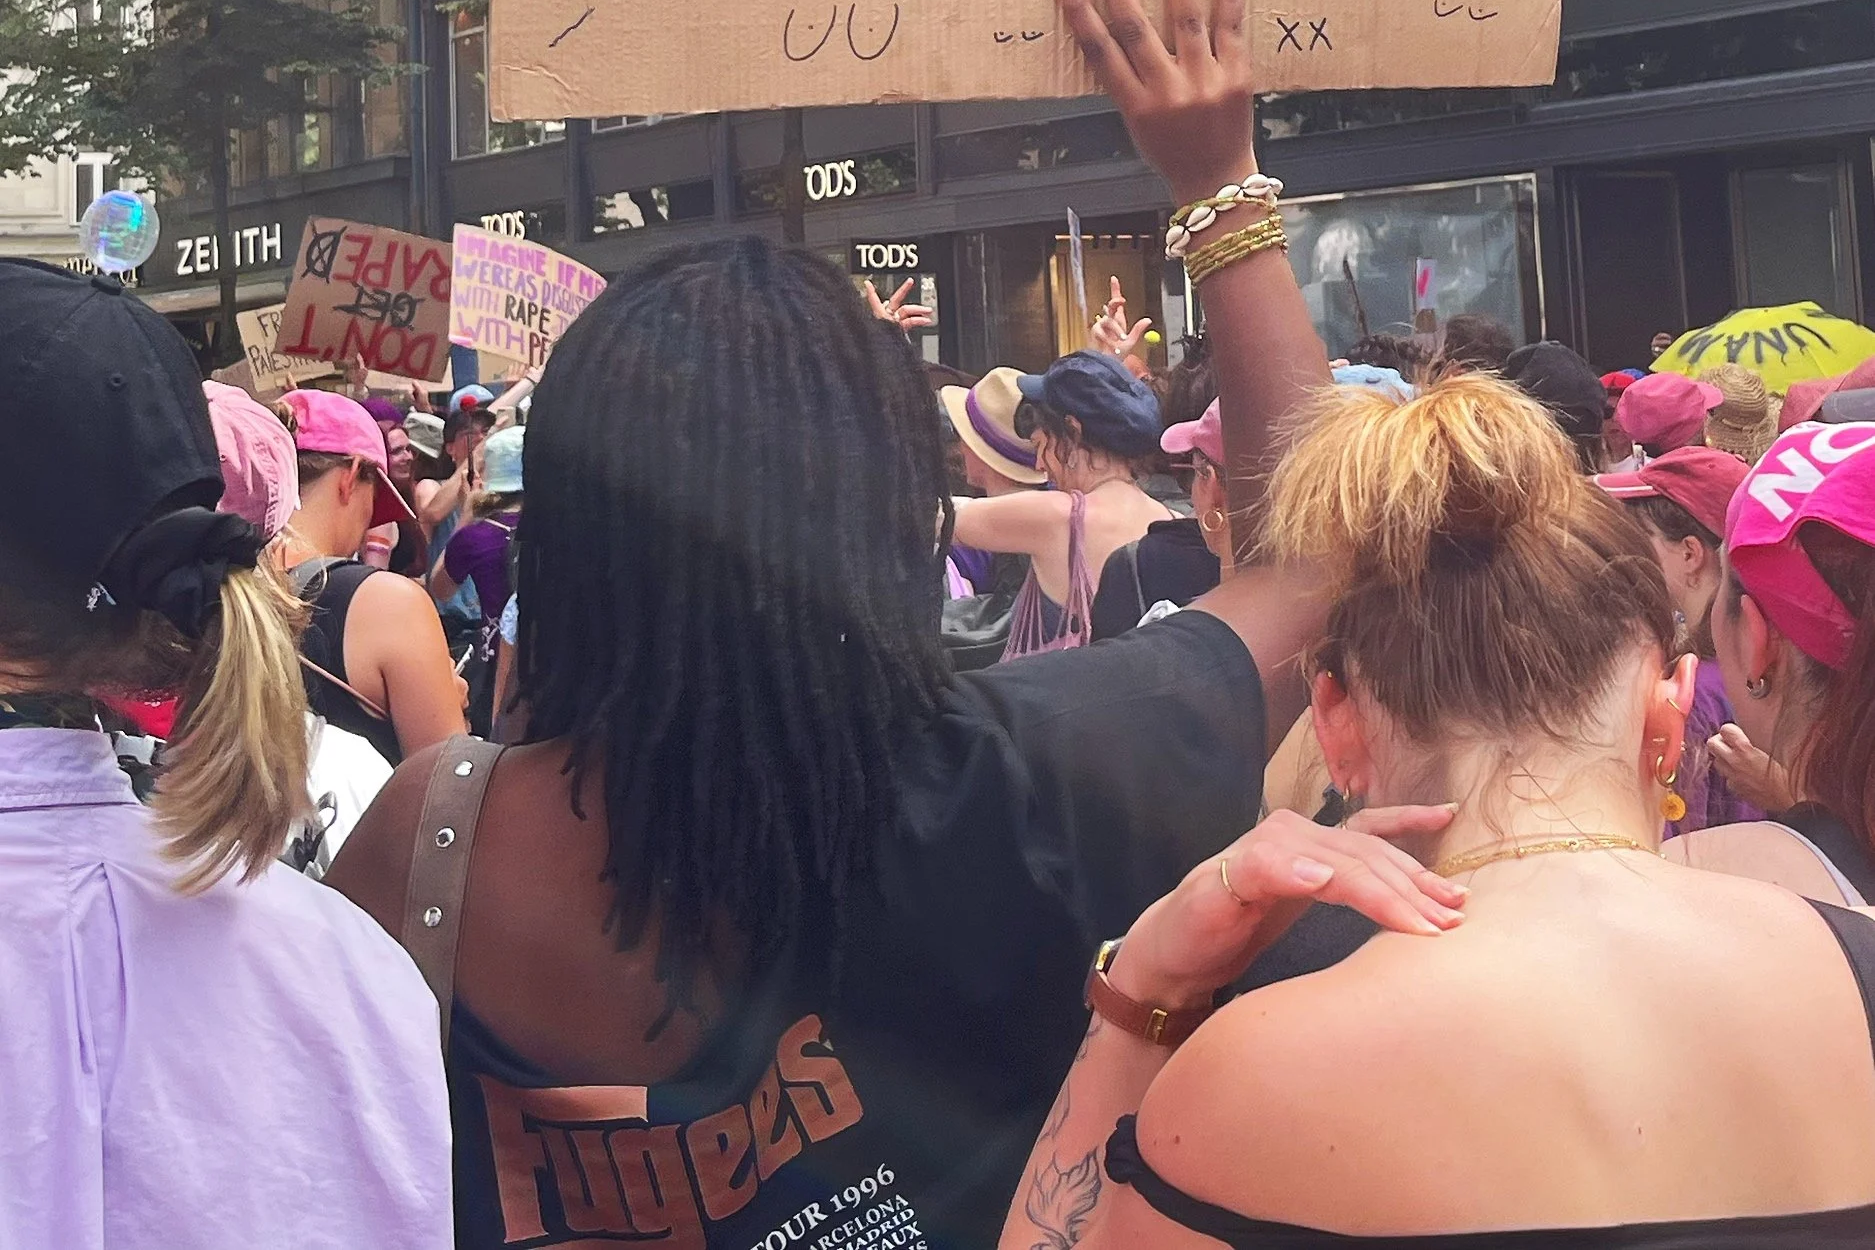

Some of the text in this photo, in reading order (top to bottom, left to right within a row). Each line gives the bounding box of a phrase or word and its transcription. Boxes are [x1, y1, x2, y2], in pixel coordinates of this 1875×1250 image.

[802, 159, 857, 200] OD'S
[457, 234, 546, 277] IMAGINE
[558, 260, 577, 288] IF
[855, 244, 919, 269] TOD'S
[257, 310, 284, 338] FR
[453, 285, 500, 314] WITH
[504, 294, 550, 336] RAPE
[284, 303, 438, 378] DON'T
[457, 312, 525, 356] WITH
[830, 1163, 895, 1212] 1996
